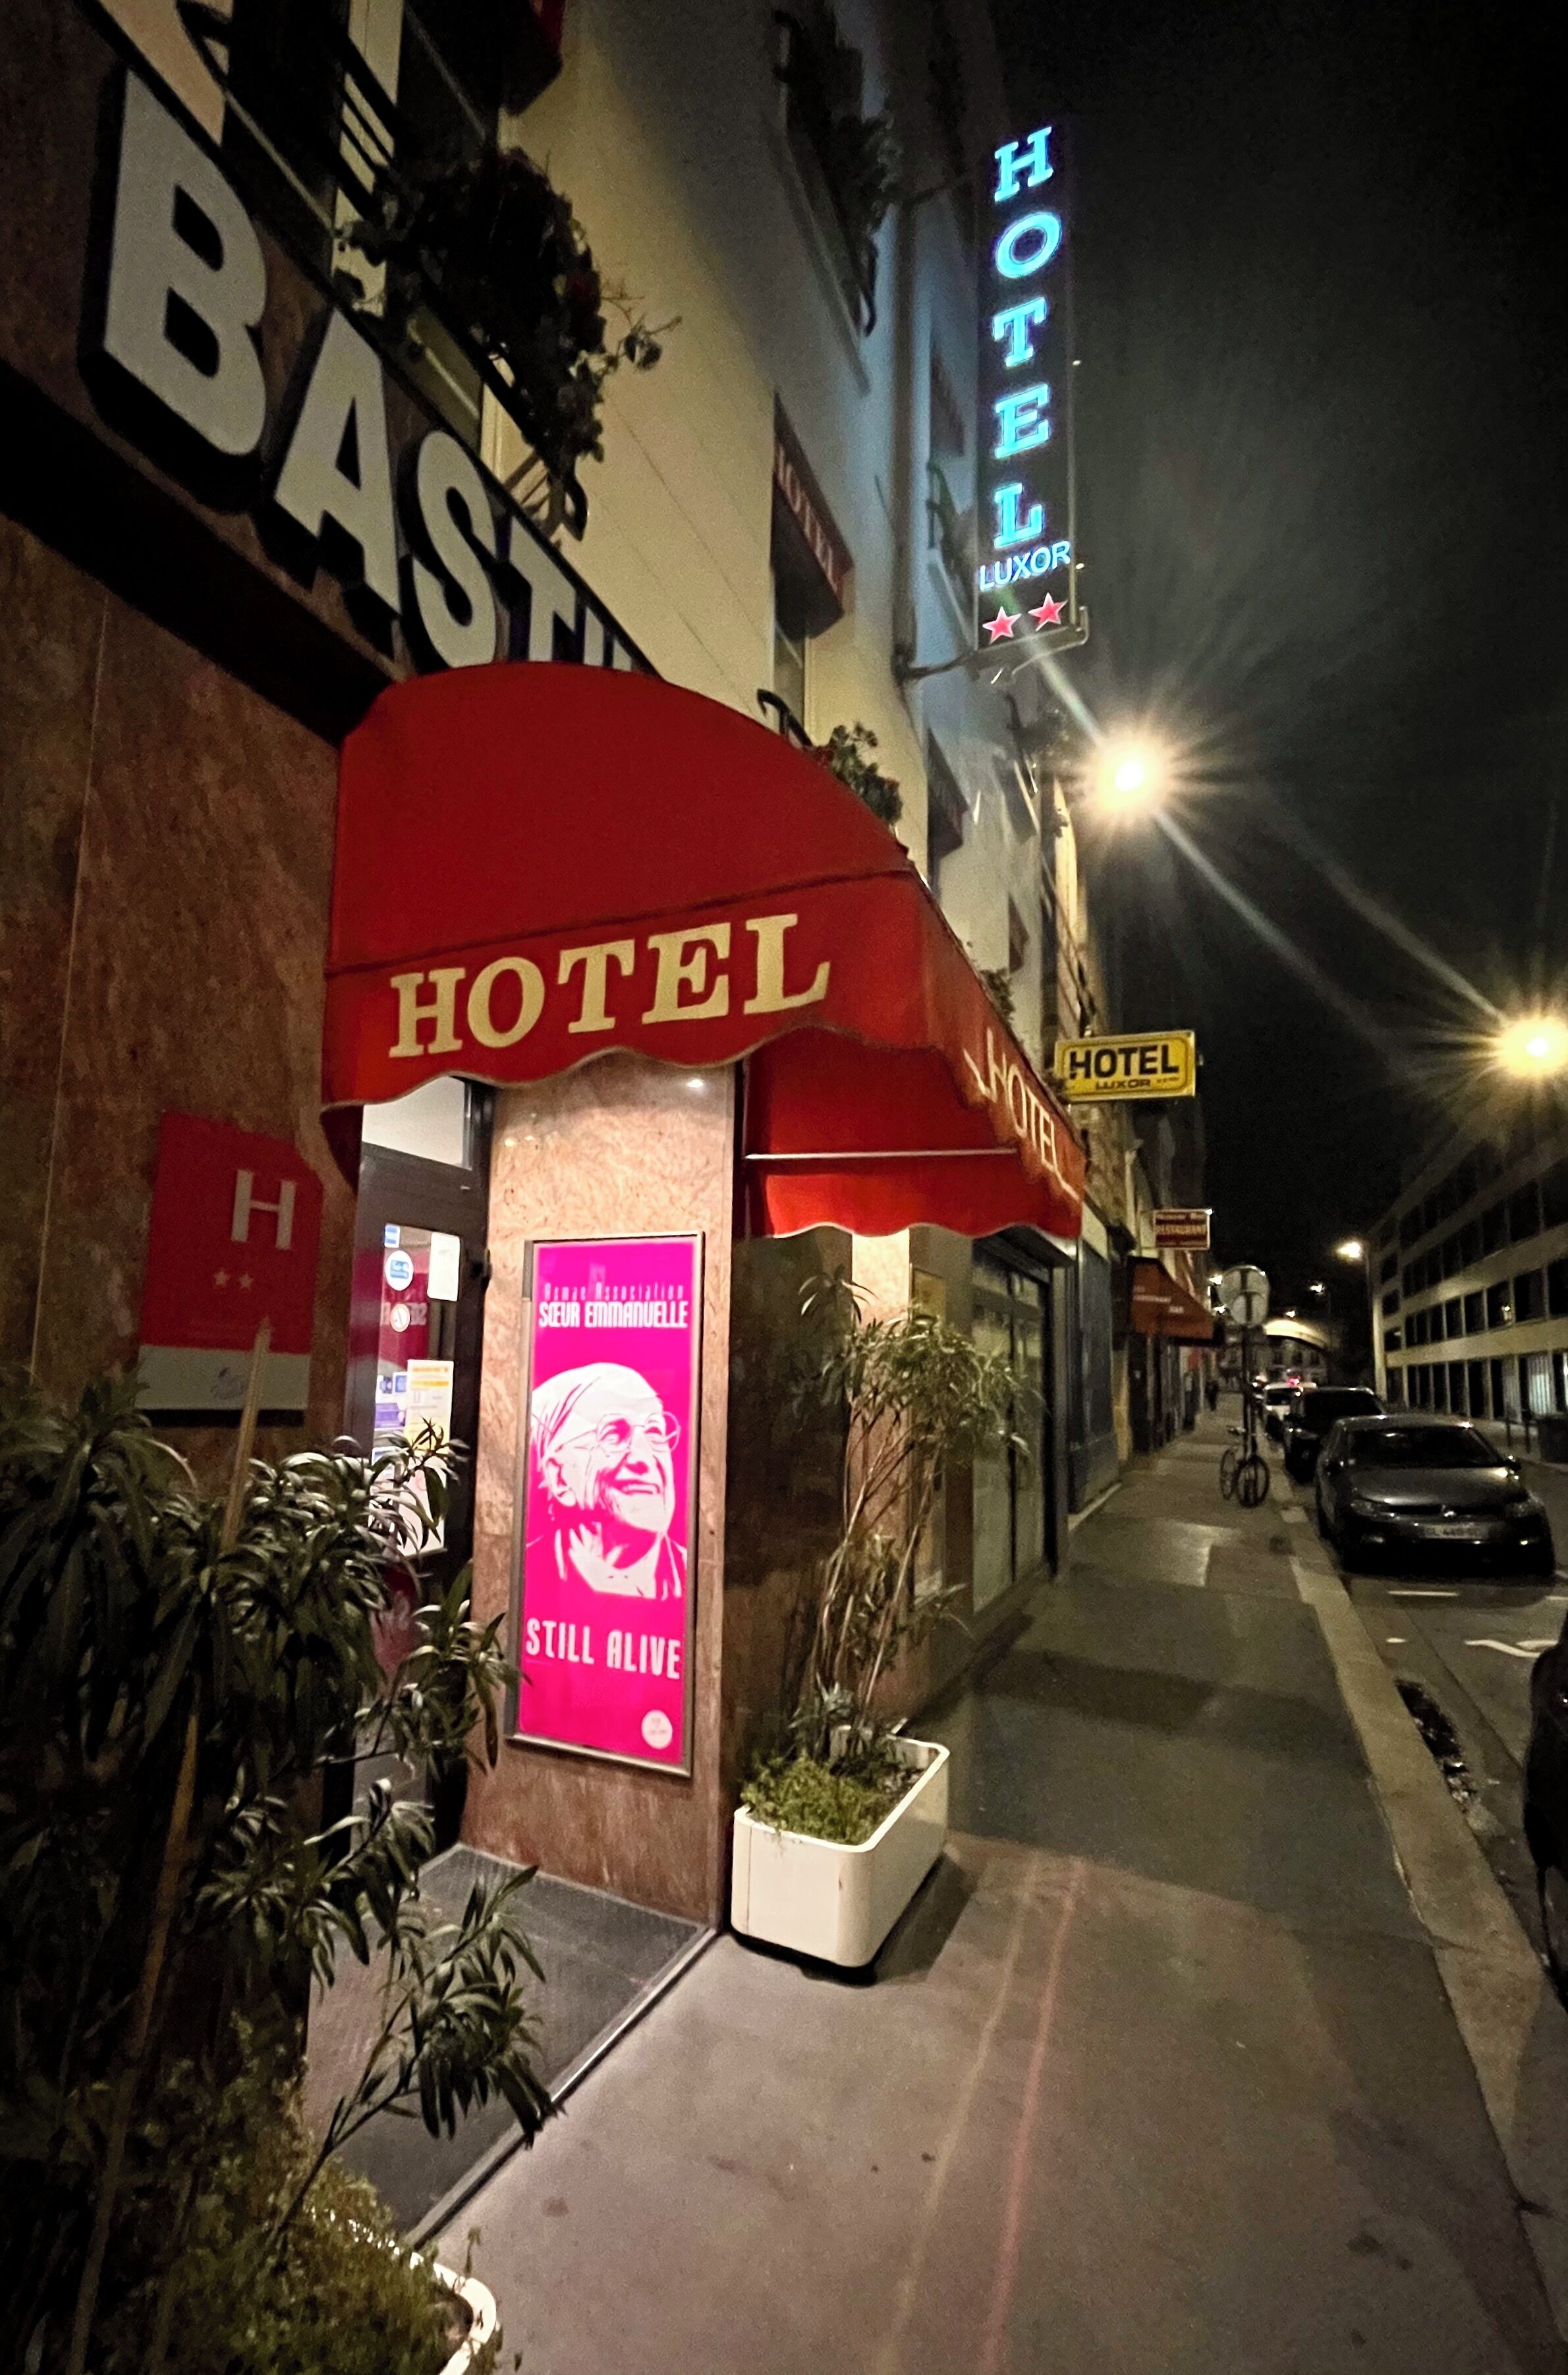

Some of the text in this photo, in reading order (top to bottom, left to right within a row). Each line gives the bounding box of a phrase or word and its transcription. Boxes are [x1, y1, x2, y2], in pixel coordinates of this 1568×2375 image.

[992, 126, 1062, 550] HOTEL
[978, 540, 1072, 592] LUXOR
[389, 913, 831, 1058] HOTEL
[1069, 1044, 1179, 1079] HOTEL
[1096, 1079, 1150, 1090] LUXOR
[963, 1027, 1079, 1201] HOTEL
[231, 1169, 296, 1250] H
[584, 1300, 688, 1328] EMMANUELLE
[526, 1618, 681, 1680] STILL ALIVE
